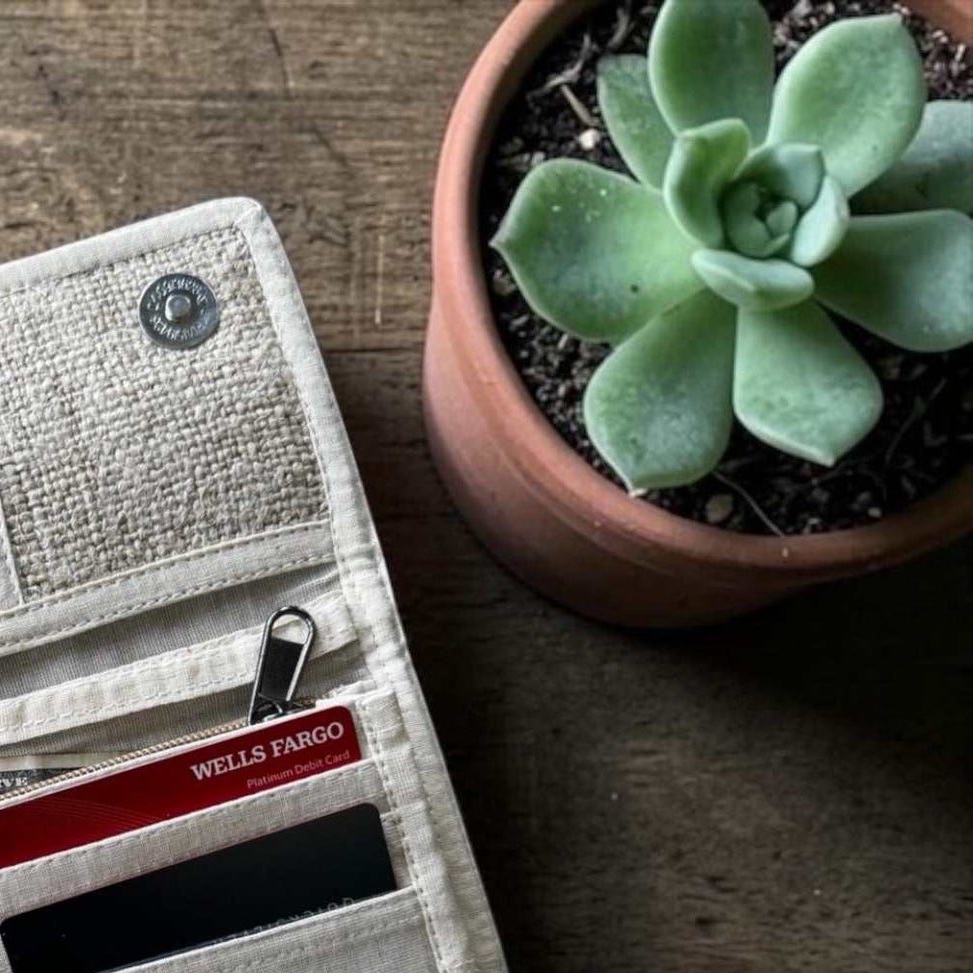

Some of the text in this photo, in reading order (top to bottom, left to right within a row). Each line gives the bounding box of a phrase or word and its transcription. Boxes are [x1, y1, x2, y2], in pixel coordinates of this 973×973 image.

[190, 722, 344, 781] WELLS FARGO
[246, 750, 351, 788] Platinum Debit Card
